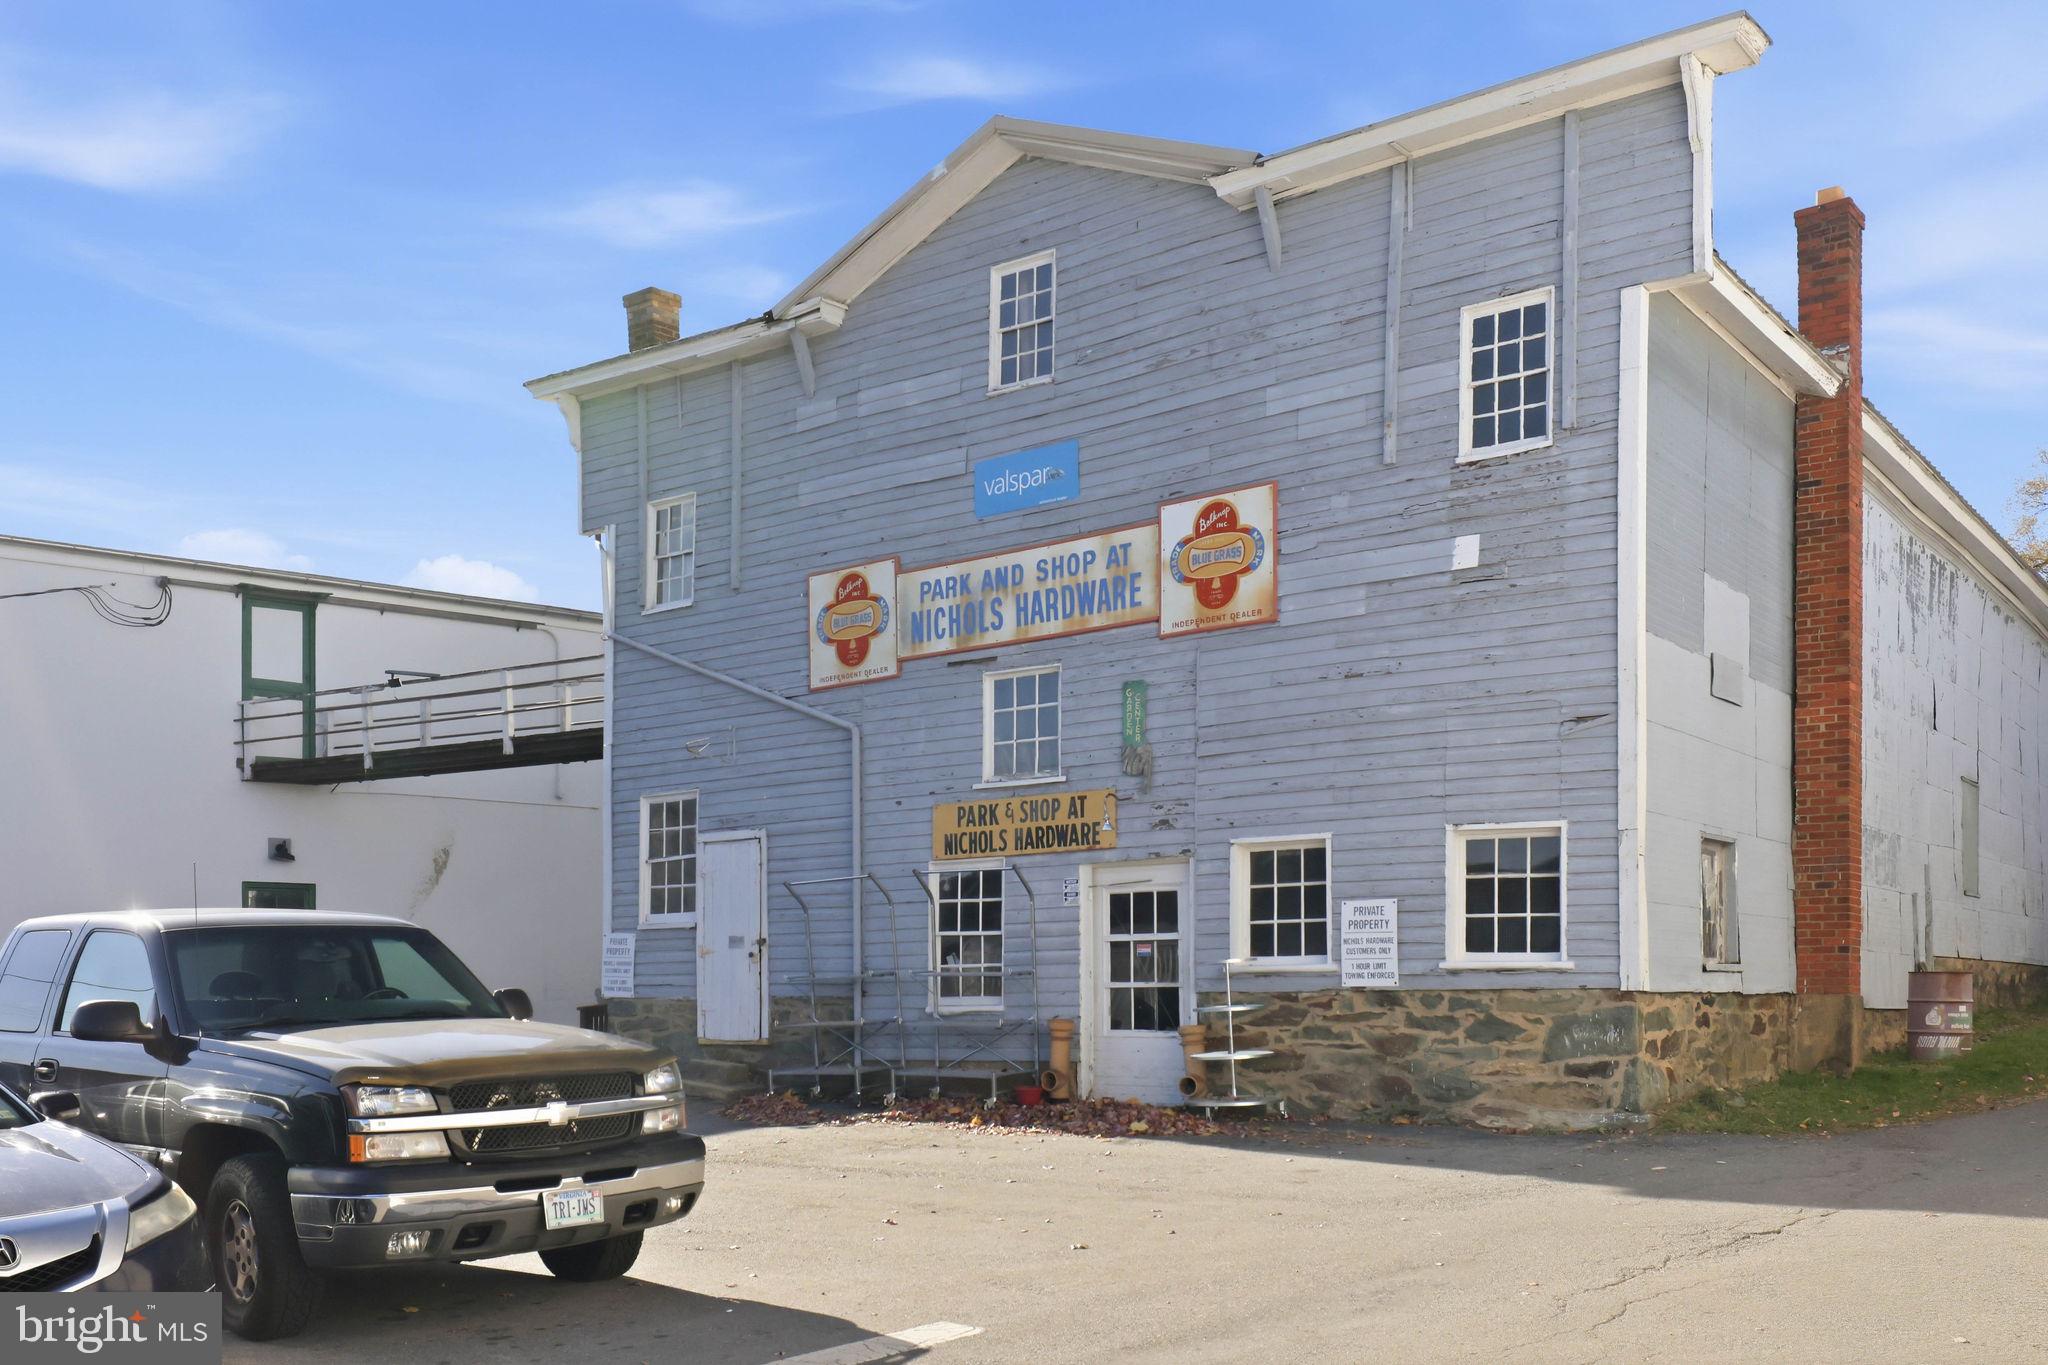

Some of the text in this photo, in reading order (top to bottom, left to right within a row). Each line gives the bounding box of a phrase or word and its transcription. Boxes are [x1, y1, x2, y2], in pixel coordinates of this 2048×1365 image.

[984, 467, 1049, 496] valspar
[1216, 521, 1229, 529] INC.
[1191, 545, 1242, 566] BLUE GRASS
[1252, 530, 1265, 567] MARK
[1171, 543, 1184, 580] TRADE
[920, 542, 1132, 603] PARK AND SHOP AT
[911, 572, 1142, 644] NICHOLS HARDWARE
[1172, 607, 1263, 628] INDEPENDENT DEALER
[820, 666, 889, 683] INDEPENDENT DEALER
[1125, 688, 1133, 736] GARDEN
[957, 795, 1087, 827] PARK & SHOP AT
[944, 821, 1101, 855] NICHOLS HARDWARE
[1353, 905, 1385, 916] PRIVATE
[1348, 919, 1390, 930] PROPERTY
[1346, 947, 1377, 955] CUSTOMERS
[1365, 937, 1395, 945] HARDWARE
[1367, 971, 1395, 979] ENFORCED
[1372, 962, 1387, 970] LIMIT
